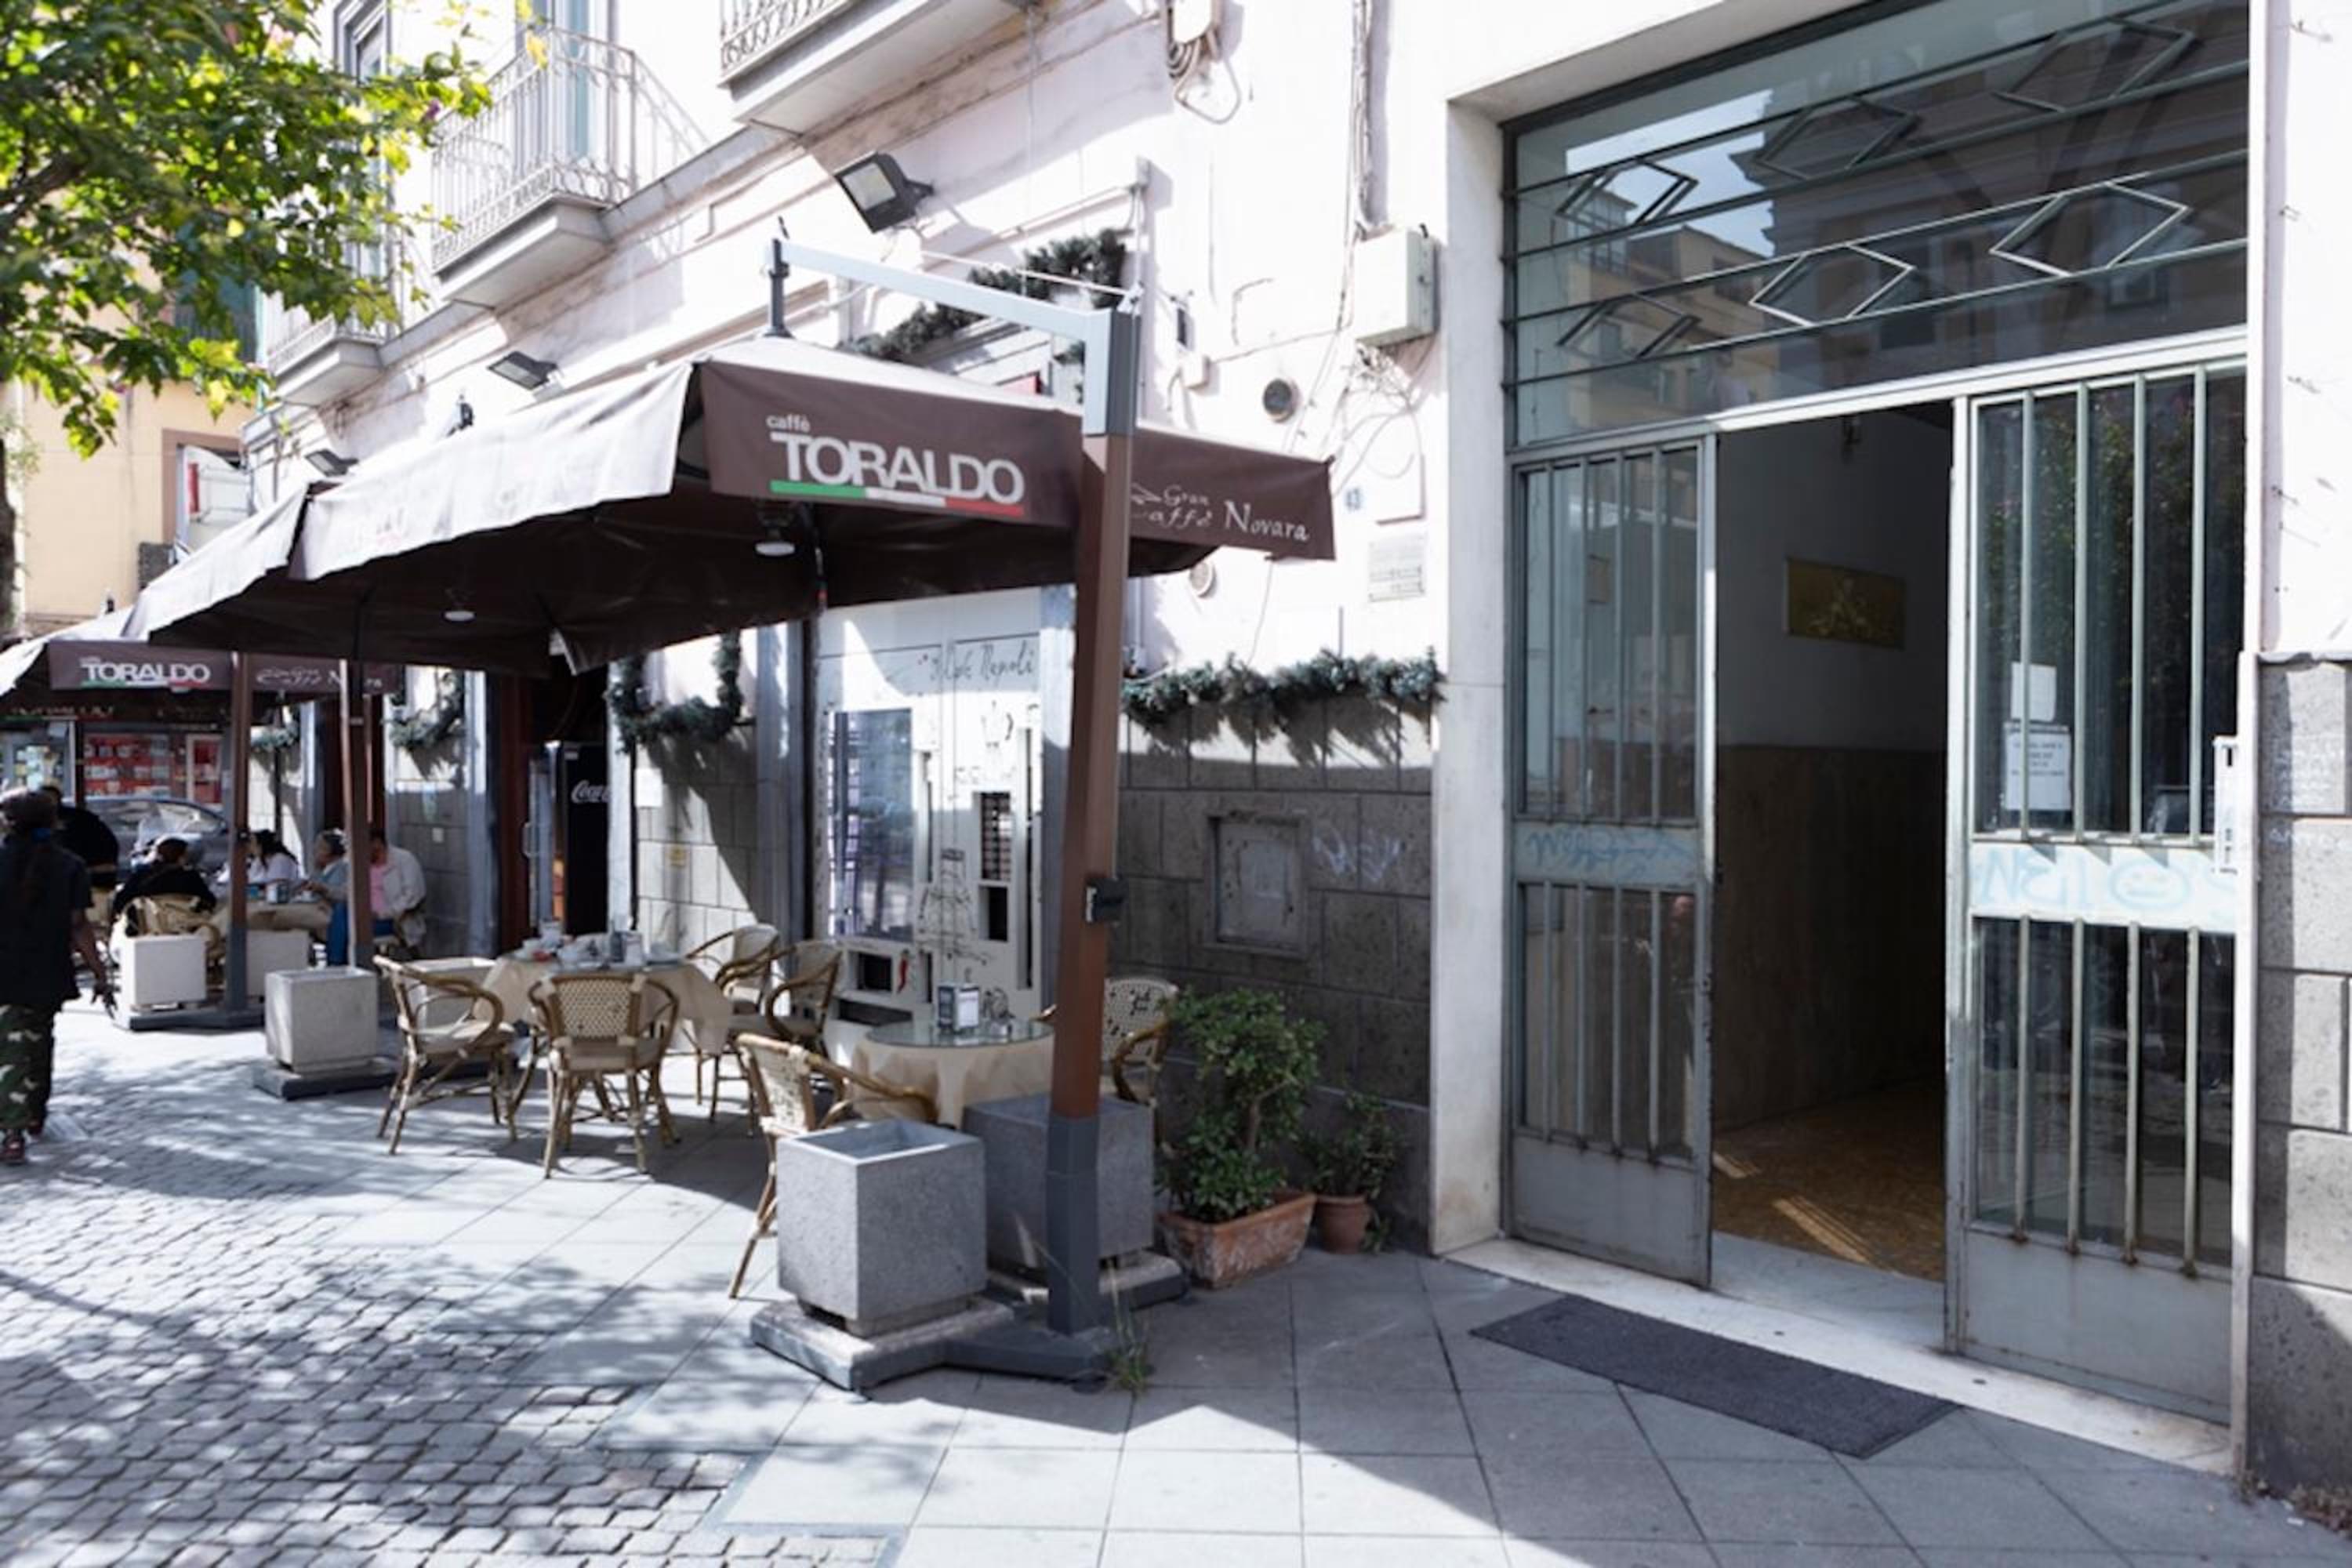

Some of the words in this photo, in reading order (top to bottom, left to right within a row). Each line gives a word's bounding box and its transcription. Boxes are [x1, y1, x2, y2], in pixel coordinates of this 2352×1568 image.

[766, 414, 811, 432] caffè
[770, 431, 1025, 505] TORALDO
[1163, 484, 1209, 506] Gran
[1224, 499, 1309, 541] Novara
[81, 663, 211, 684] TORALDO
